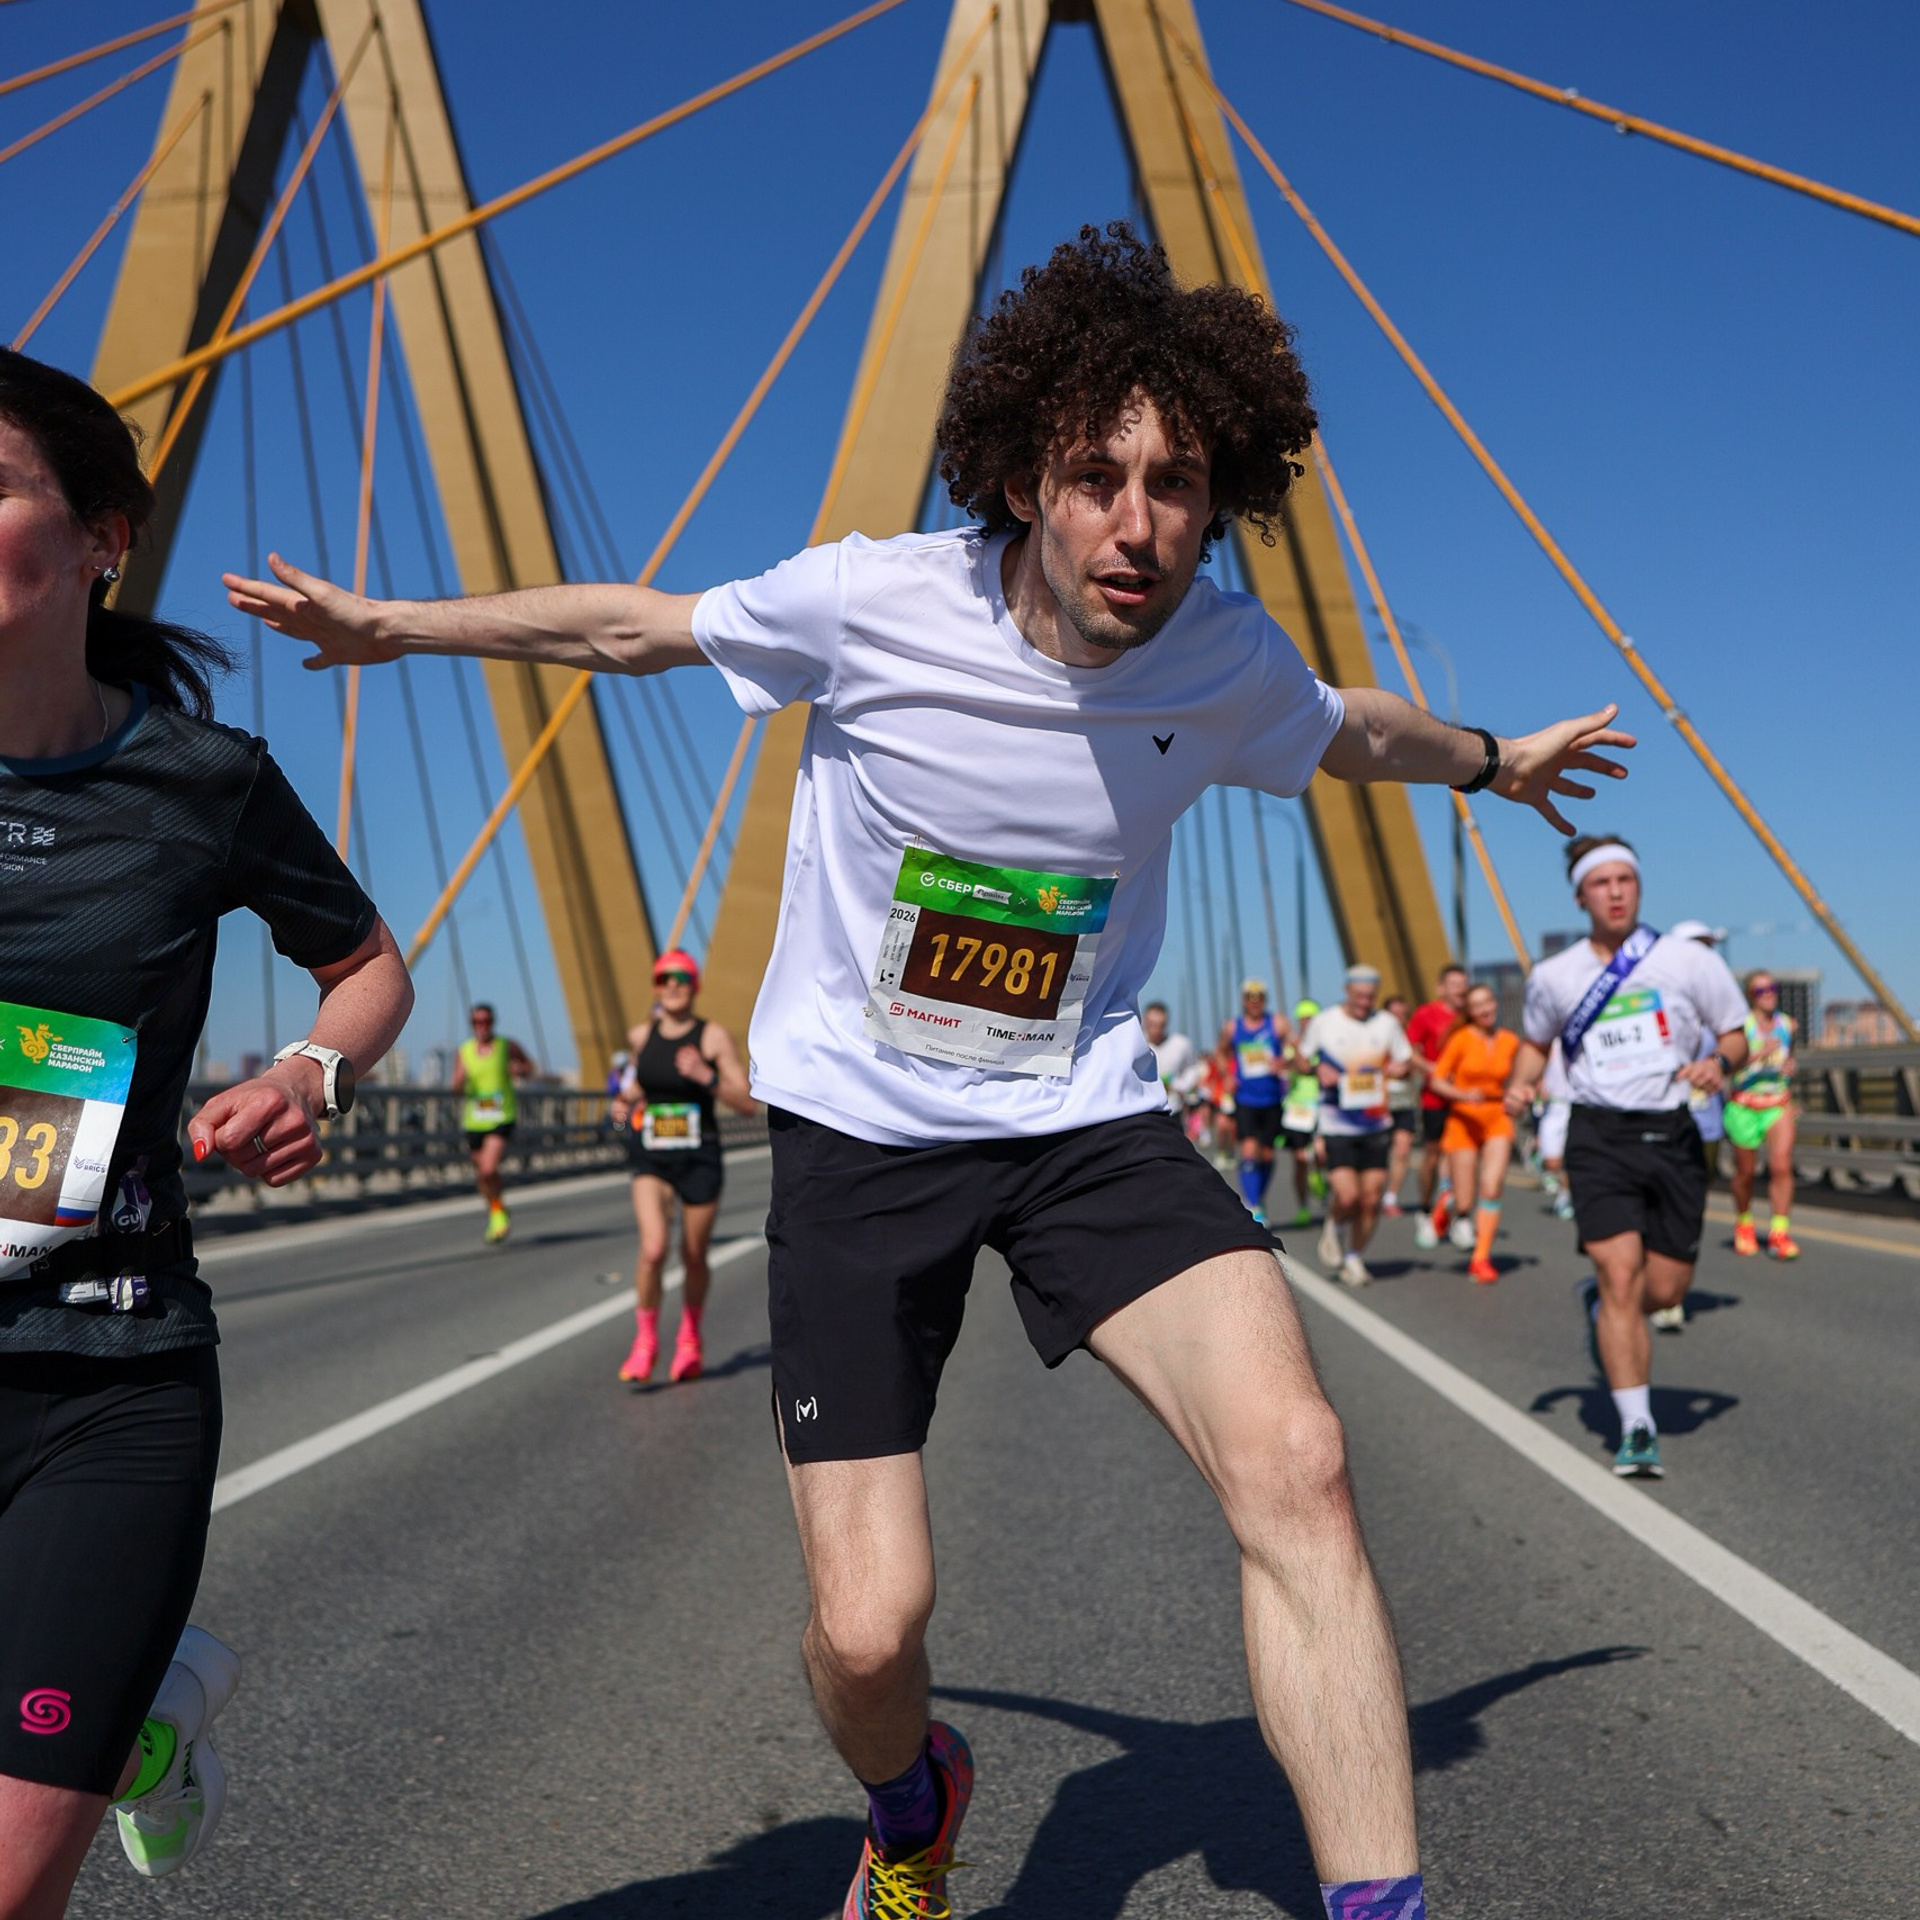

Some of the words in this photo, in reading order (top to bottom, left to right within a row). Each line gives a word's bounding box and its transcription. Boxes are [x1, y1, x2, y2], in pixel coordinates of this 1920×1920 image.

[0, 821, 27, 843] R
[937, 878, 972, 894] СБЕР
[890, 908, 916, 922] 2026
[930, 933, 1058, 1000] 17981
[906, 1008, 962, 1029] МАГНИТ
[51, 1043, 102, 1058] СБЕРПРАЙМ
[925, 1044, 955, 1056] Питание
[956, 1051, 977, 1060] после
[47, 1060, 93, 1073] МАРАФОН
[49, 1052, 105, 1068] КАЗАНСКИЙ
[83, 1163, 106, 1173] BRICS
[118, 1214, 140, 1227] GU
